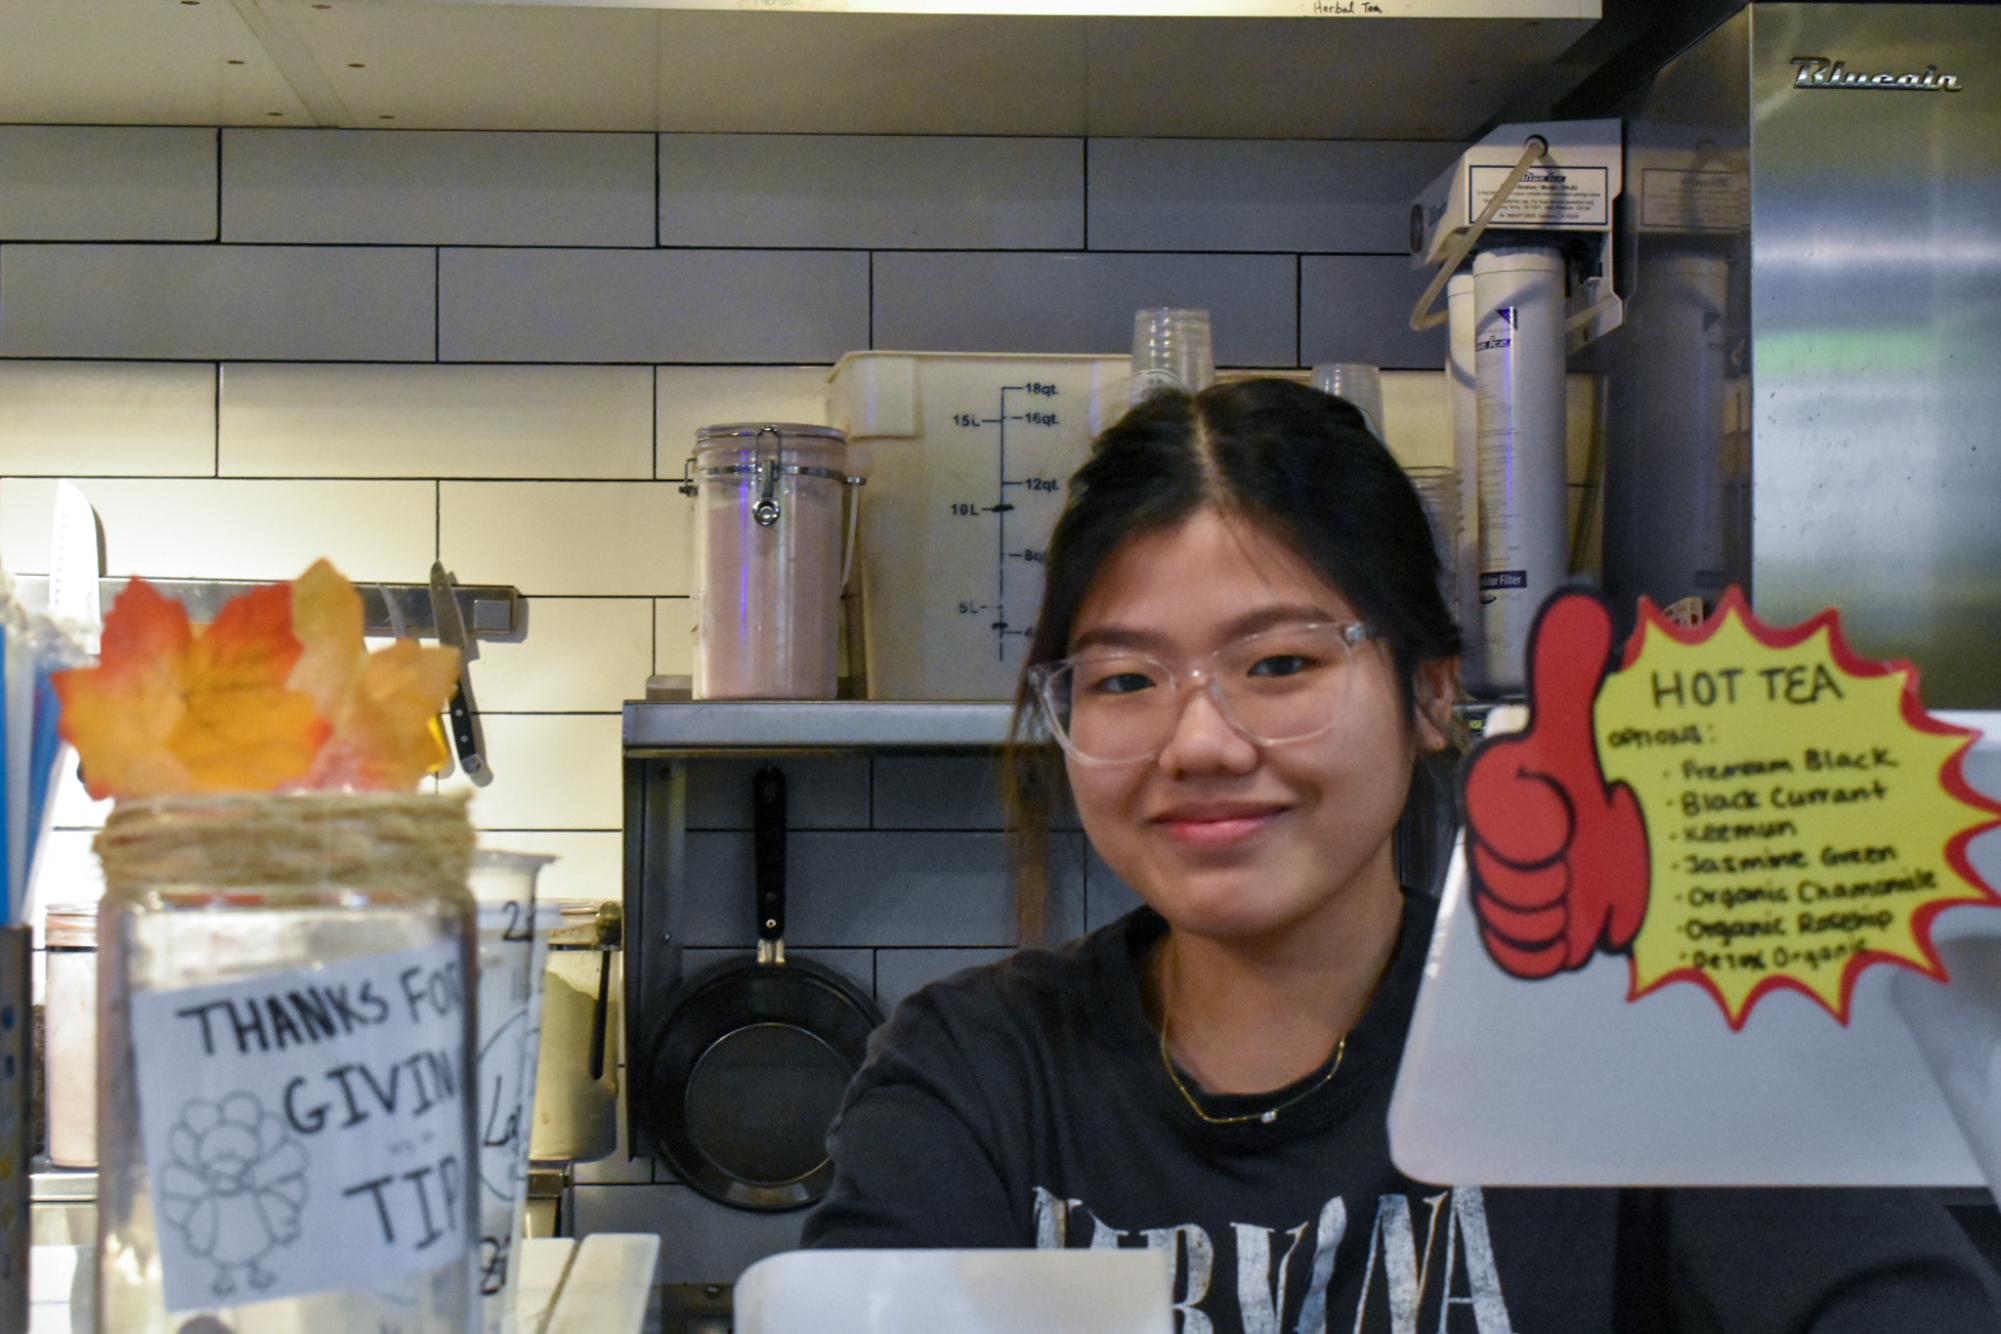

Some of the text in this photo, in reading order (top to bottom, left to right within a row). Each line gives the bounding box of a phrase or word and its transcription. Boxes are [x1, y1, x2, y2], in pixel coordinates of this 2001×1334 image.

[1314, 1, 1383, 14] Herbal Tea
[953, 414, 980, 427] 15L
[950, 503, 979, 516] 10L
[1652, 663, 1844, 708] HOT TEA
[1805, 747, 1898, 772] Black
[1681, 778, 1887, 817] Black Currant
[1683, 846, 1897, 875] Jasmine Green
[1688, 869, 1937, 909] Organic Chamomile
[1686, 914, 1787, 947] Organic
[176, 981, 390, 1056] THANKS
